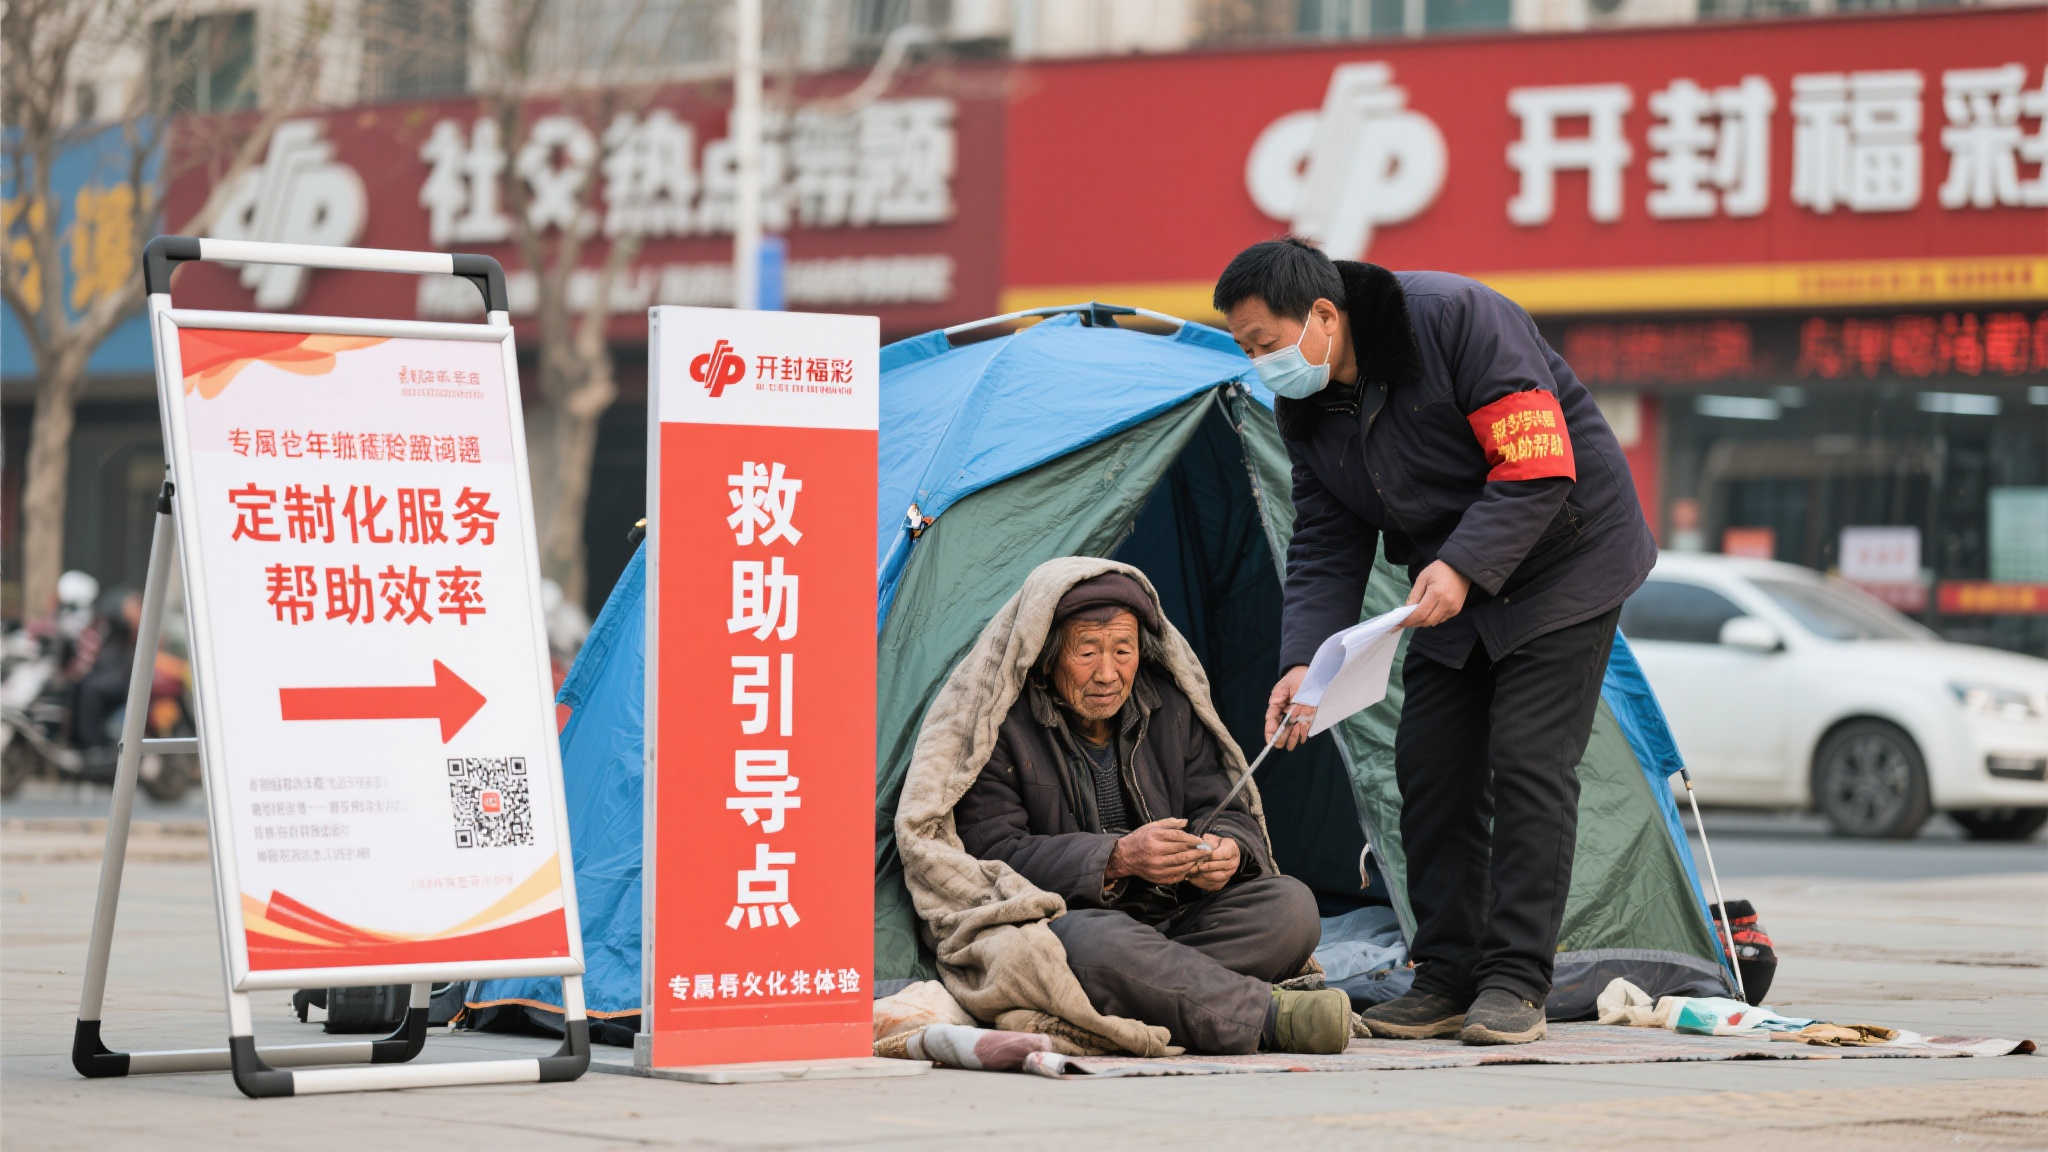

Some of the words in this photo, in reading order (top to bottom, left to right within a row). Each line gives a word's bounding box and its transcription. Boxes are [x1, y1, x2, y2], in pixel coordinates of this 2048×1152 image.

[755, 355, 853, 384] 开封福彩
[228, 482, 501, 546] 定制化服务
[265, 562, 487, 626] 帮助效率
[726, 461, 804, 930] 救助引导点
